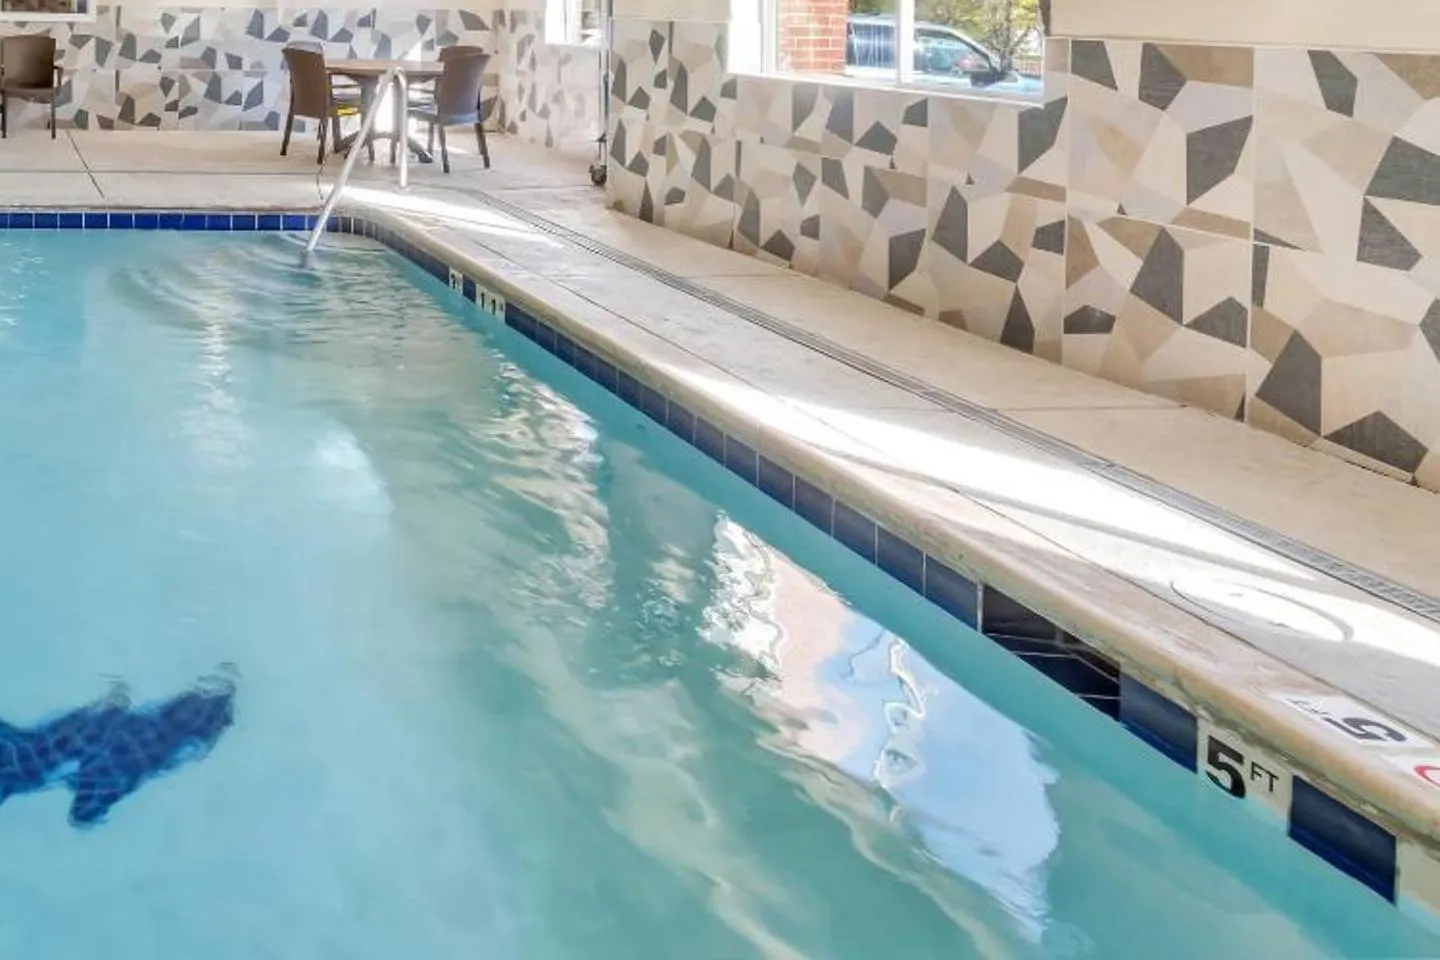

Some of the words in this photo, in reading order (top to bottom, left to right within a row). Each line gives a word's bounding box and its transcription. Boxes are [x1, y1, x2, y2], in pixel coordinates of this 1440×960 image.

[1322, 717, 1407, 742] 5
[1205, 734, 1247, 799] 5
[1250, 761, 1280, 793] FT
